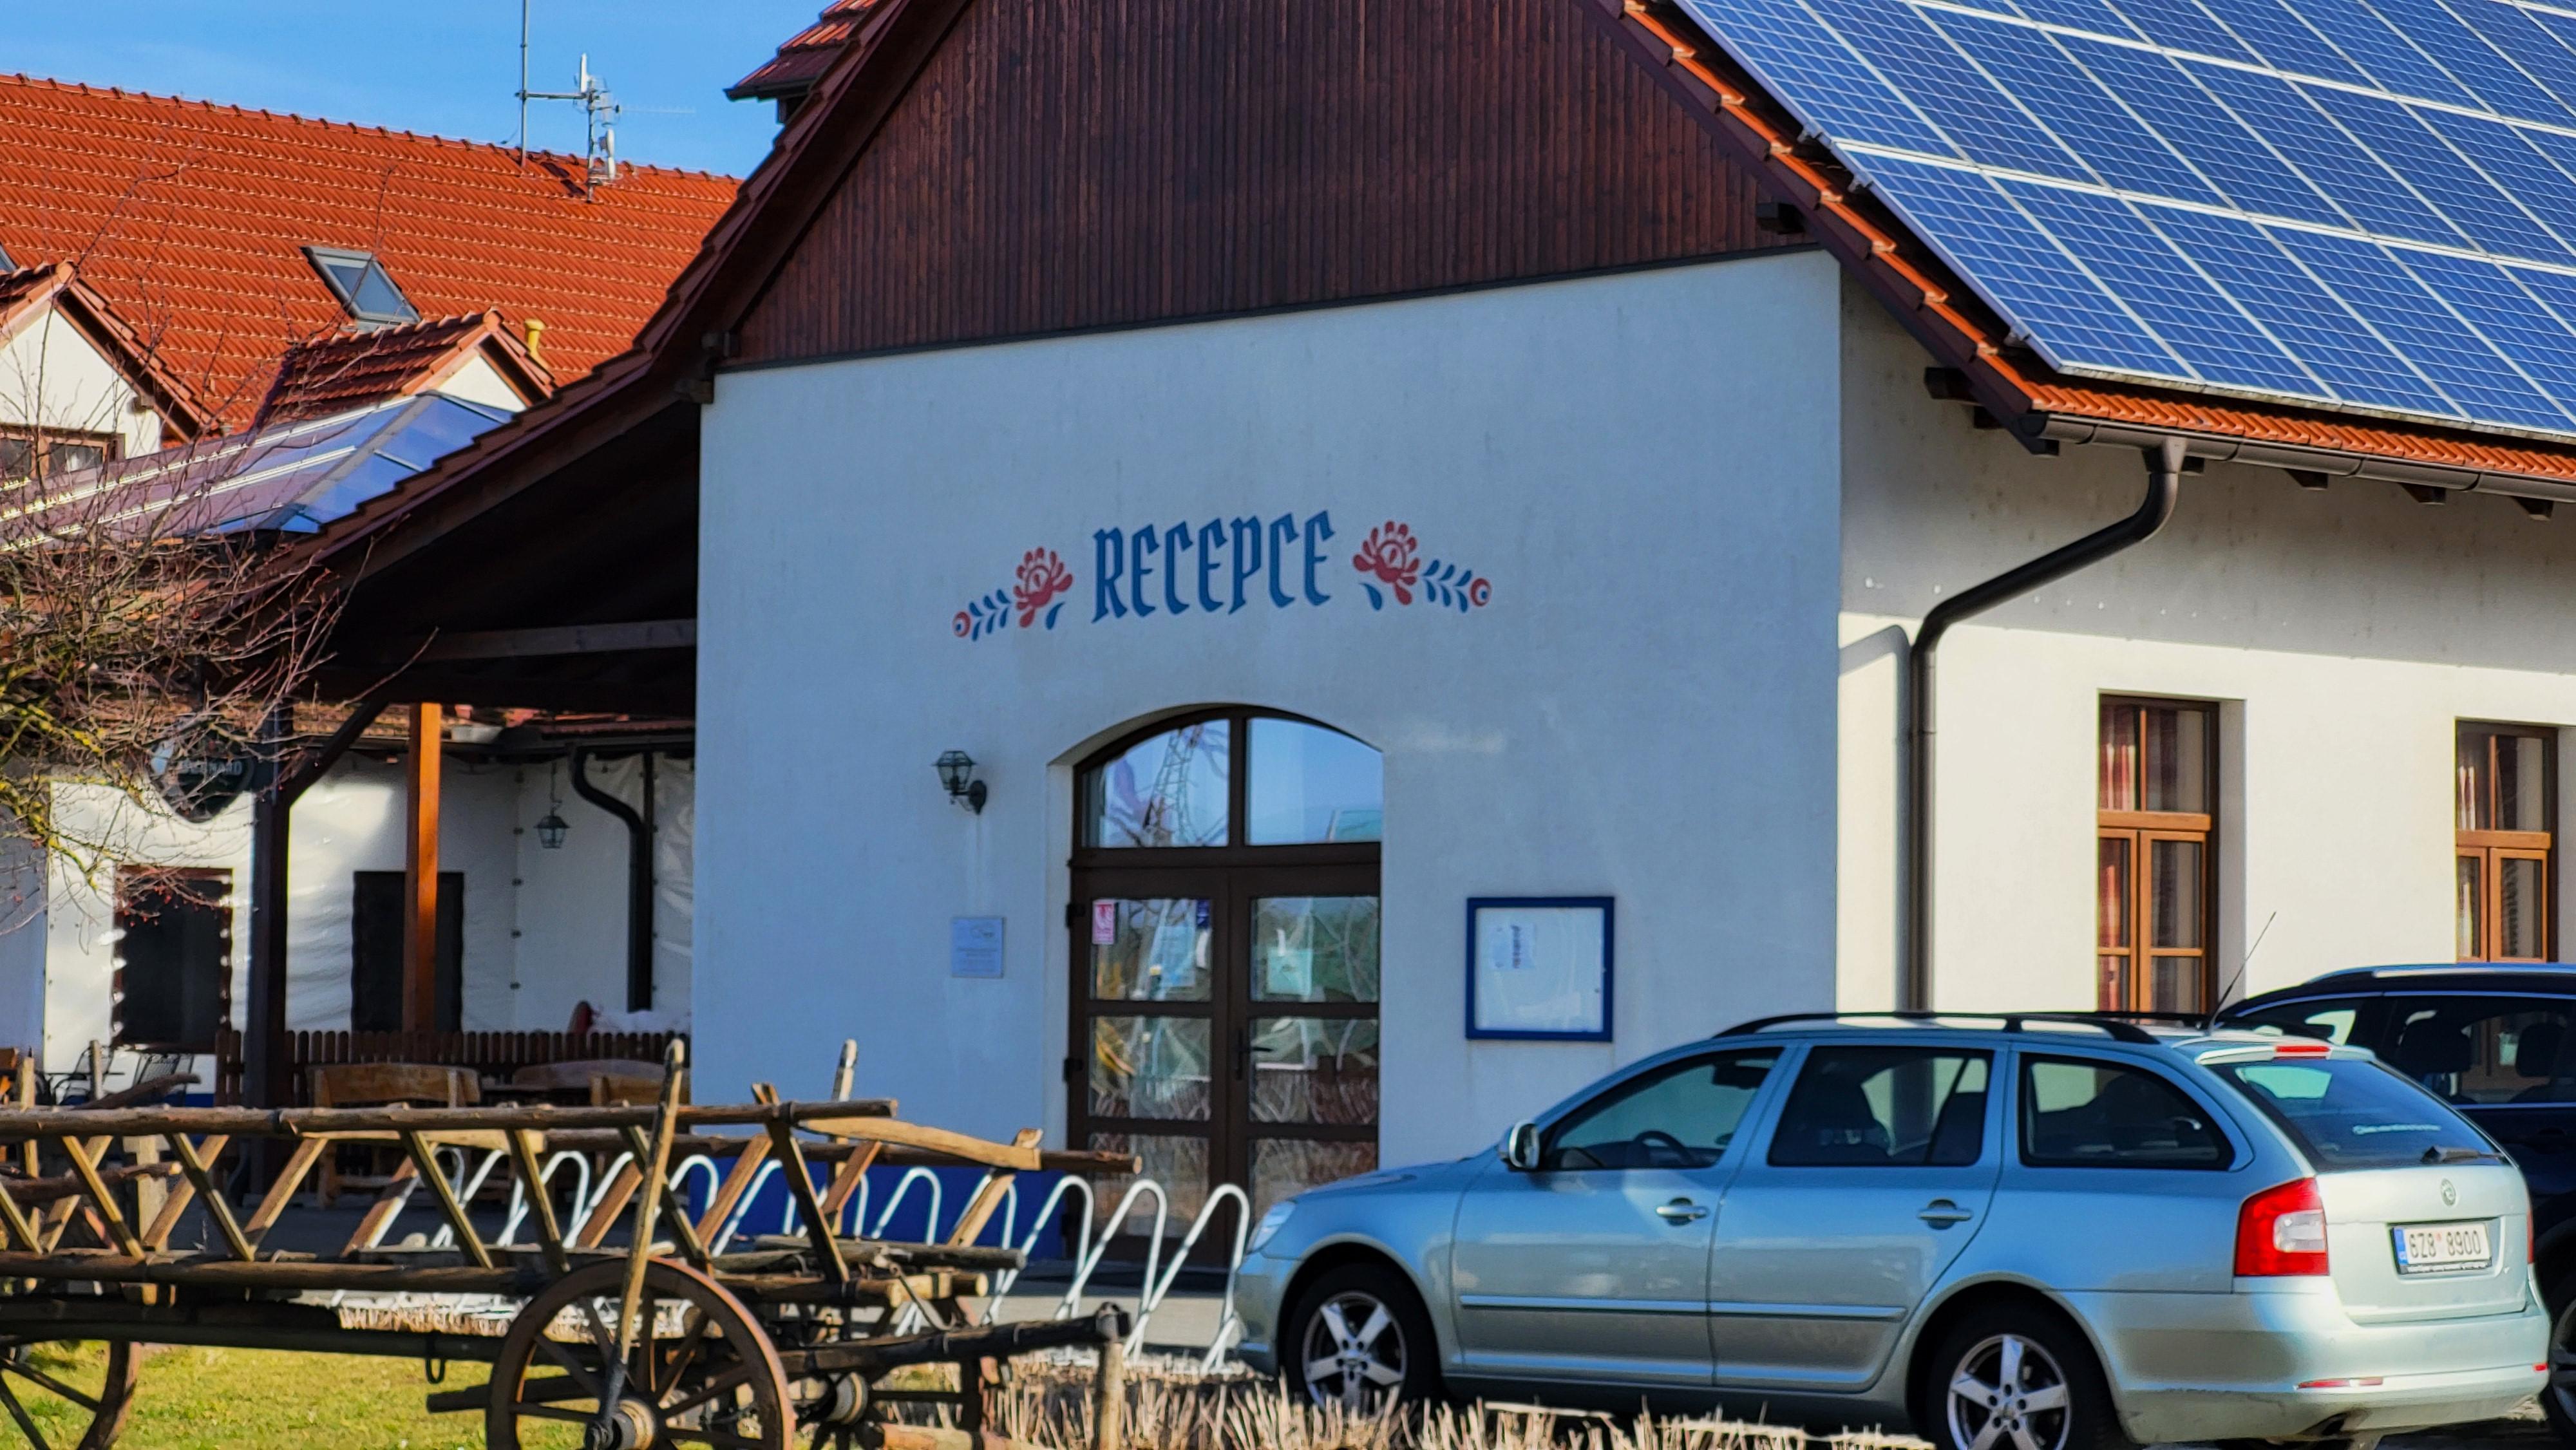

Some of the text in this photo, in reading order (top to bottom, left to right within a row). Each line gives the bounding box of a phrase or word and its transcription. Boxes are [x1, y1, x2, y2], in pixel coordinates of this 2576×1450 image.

[1092, 510, 1336, 623] RECEPCE
[2409, 1230, 2481, 1258] 6Z8 8900
